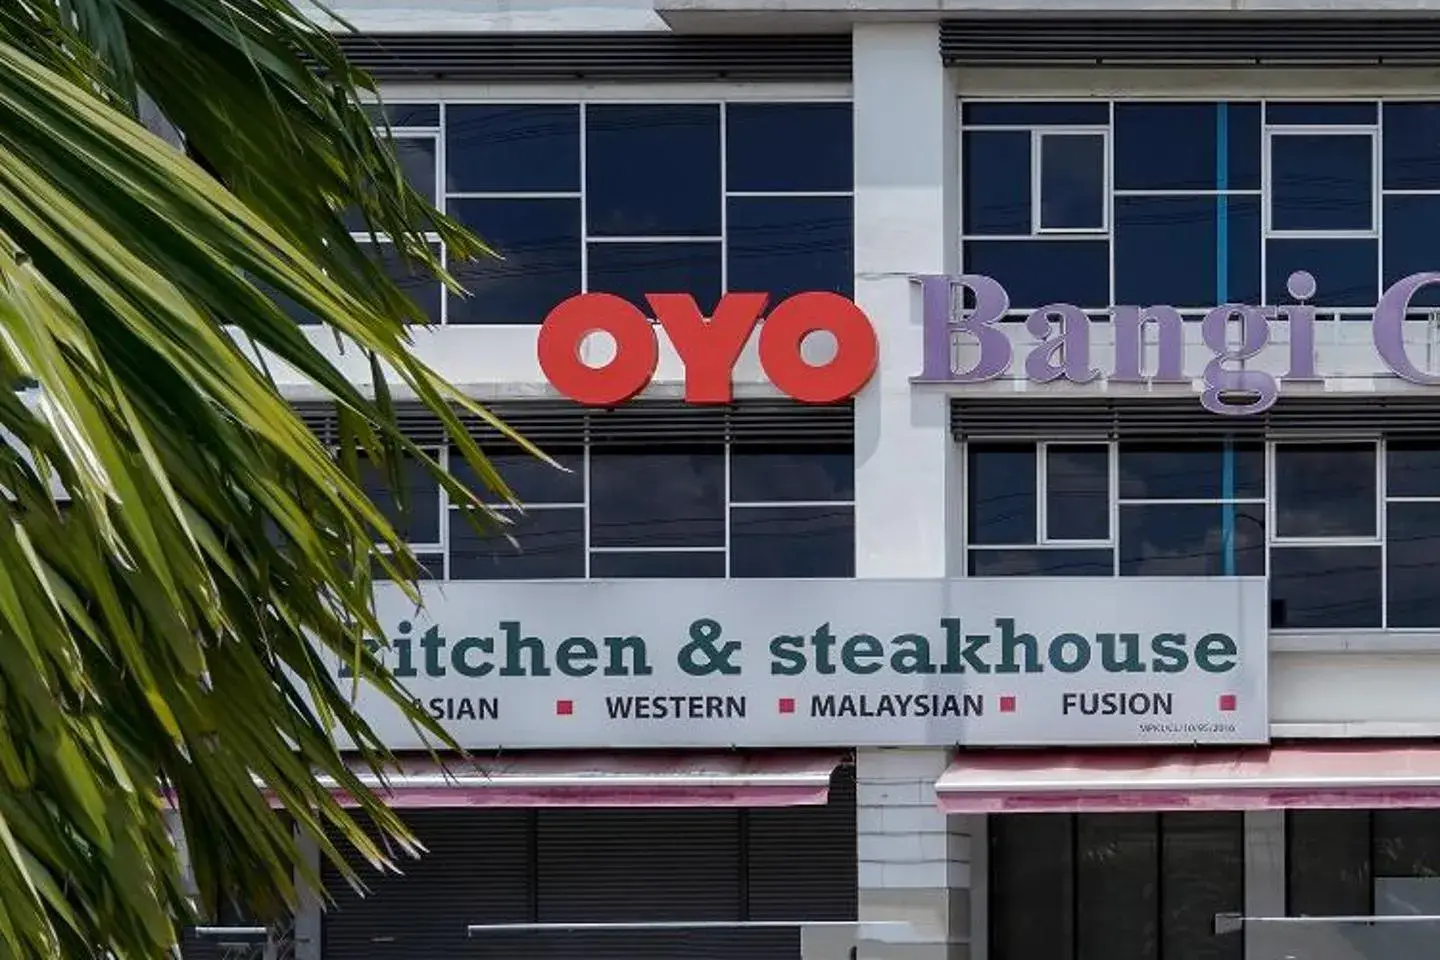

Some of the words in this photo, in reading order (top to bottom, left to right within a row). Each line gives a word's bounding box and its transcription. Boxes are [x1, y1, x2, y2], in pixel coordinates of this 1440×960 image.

[537, 291, 880, 405] OYO
[908, 270, 1319, 415] Bangi
[676, 617, 744, 678] &
[768, 615, 1239, 677] steakhouse
[605, 694, 747, 720] WESTERN
[810, 693, 985, 719] MALAYSIAN
[1061, 692, 1174, 716] FUSION
